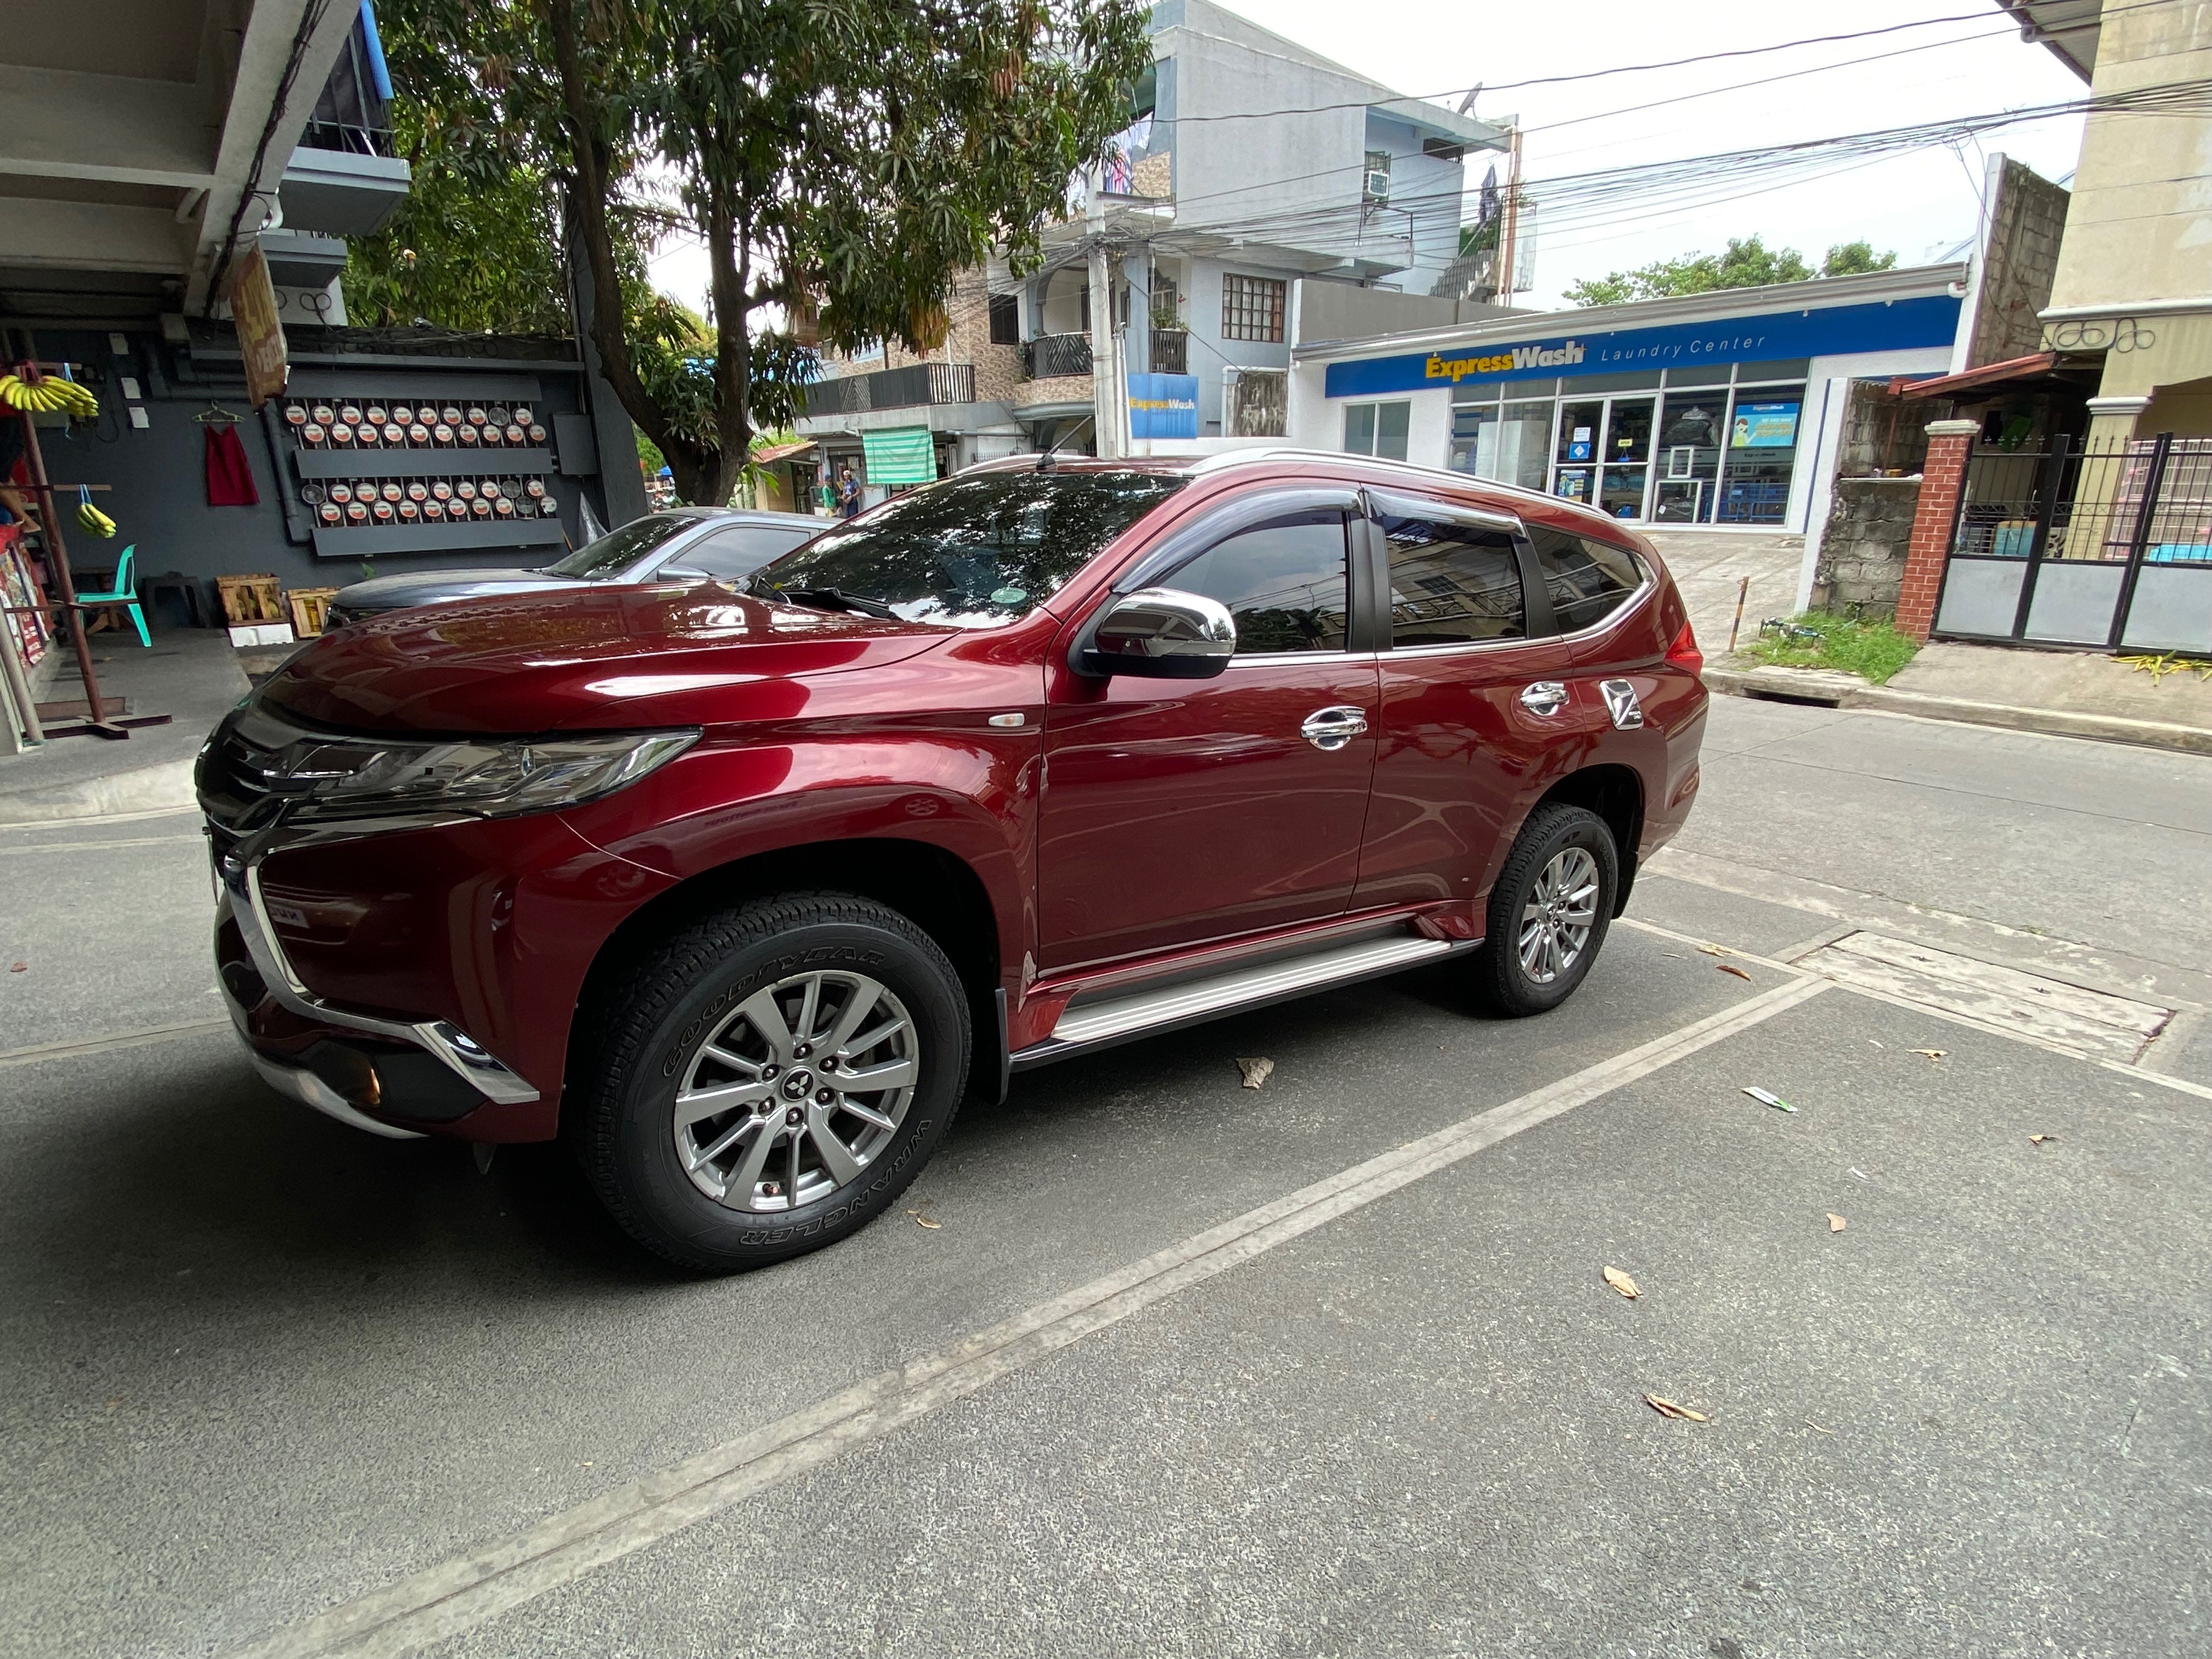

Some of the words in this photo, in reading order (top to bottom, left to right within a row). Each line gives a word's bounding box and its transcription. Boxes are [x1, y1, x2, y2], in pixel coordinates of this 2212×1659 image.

[1425, 341, 1585, 382] ExpressWash
[1601, 344, 1681, 361] Laundry
[1690, 336, 1765, 353] Center
[739, 1119, 932, 1245] WRANGLER
